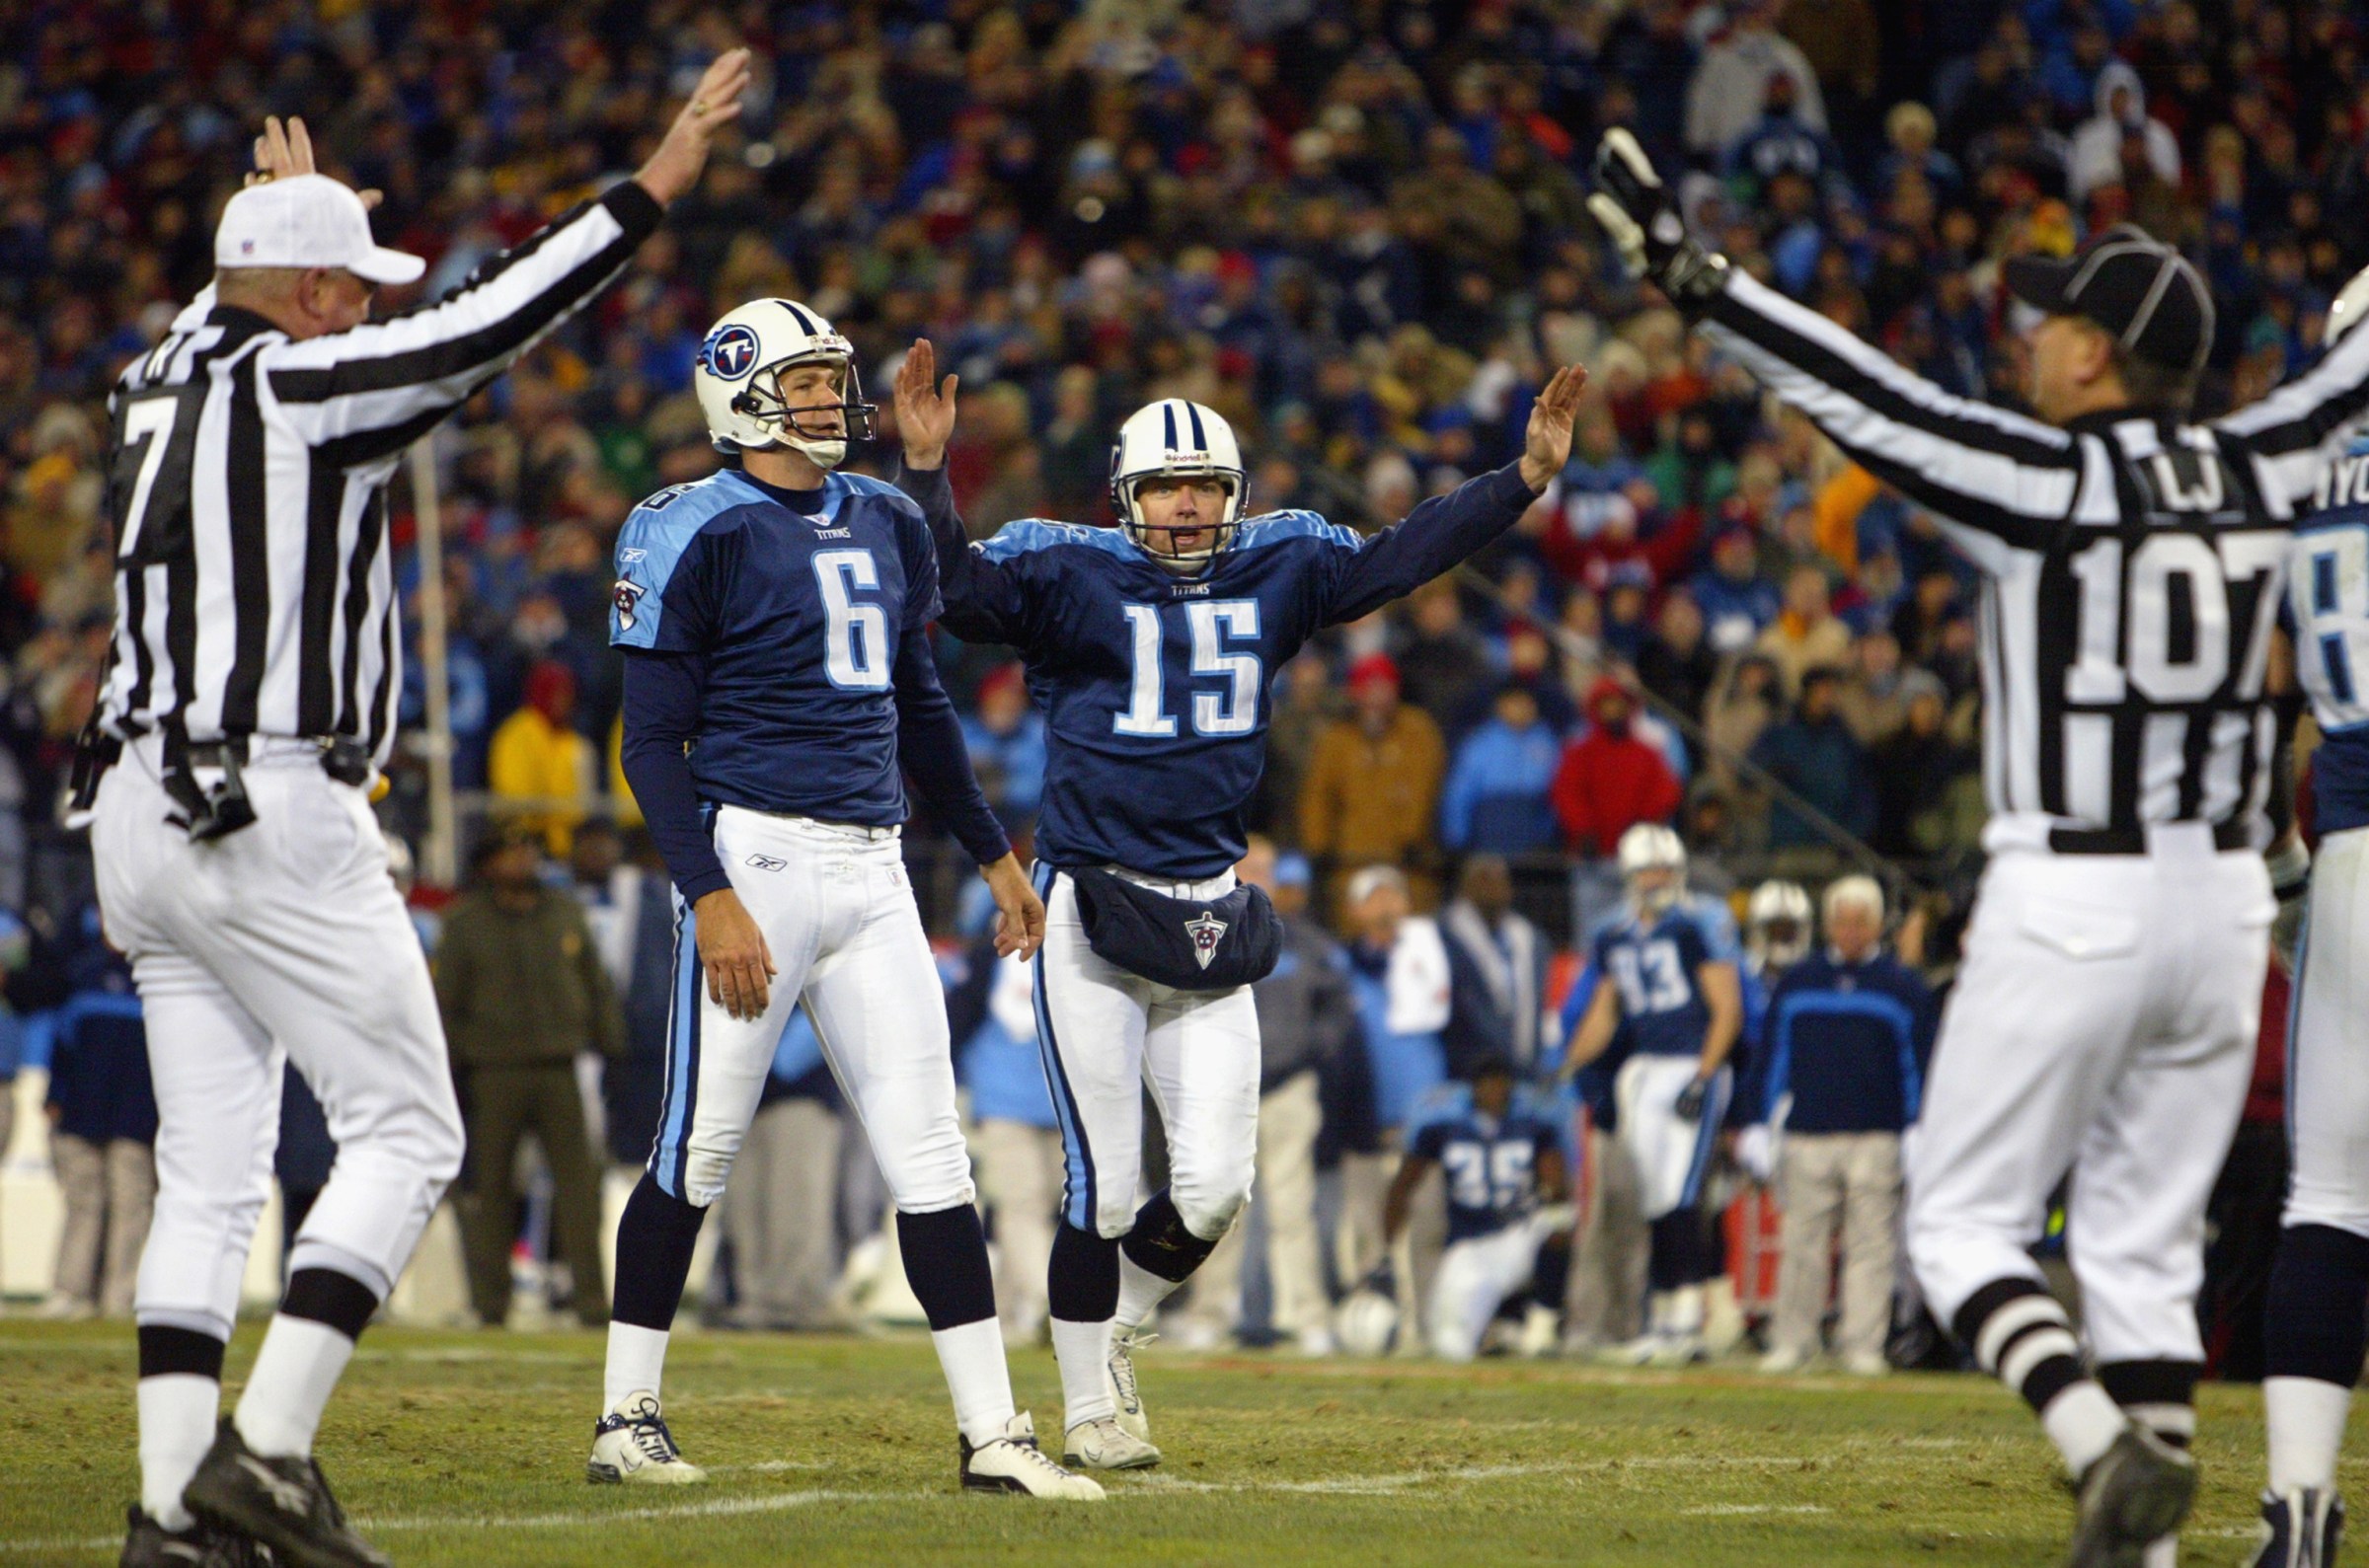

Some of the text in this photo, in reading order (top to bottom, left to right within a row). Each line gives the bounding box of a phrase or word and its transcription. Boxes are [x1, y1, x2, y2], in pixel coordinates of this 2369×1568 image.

[117, 396, 179, 559] 7
[813, 526, 851, 541] TITANS
[2154, 452, 2223, 511] LJ
[810, 548, 890, 692] 6
[1171, 582, 1210, 596] TITANS
[2064, 528, 2294, 705] 107
[1112, 598, 1262, 737] 15
